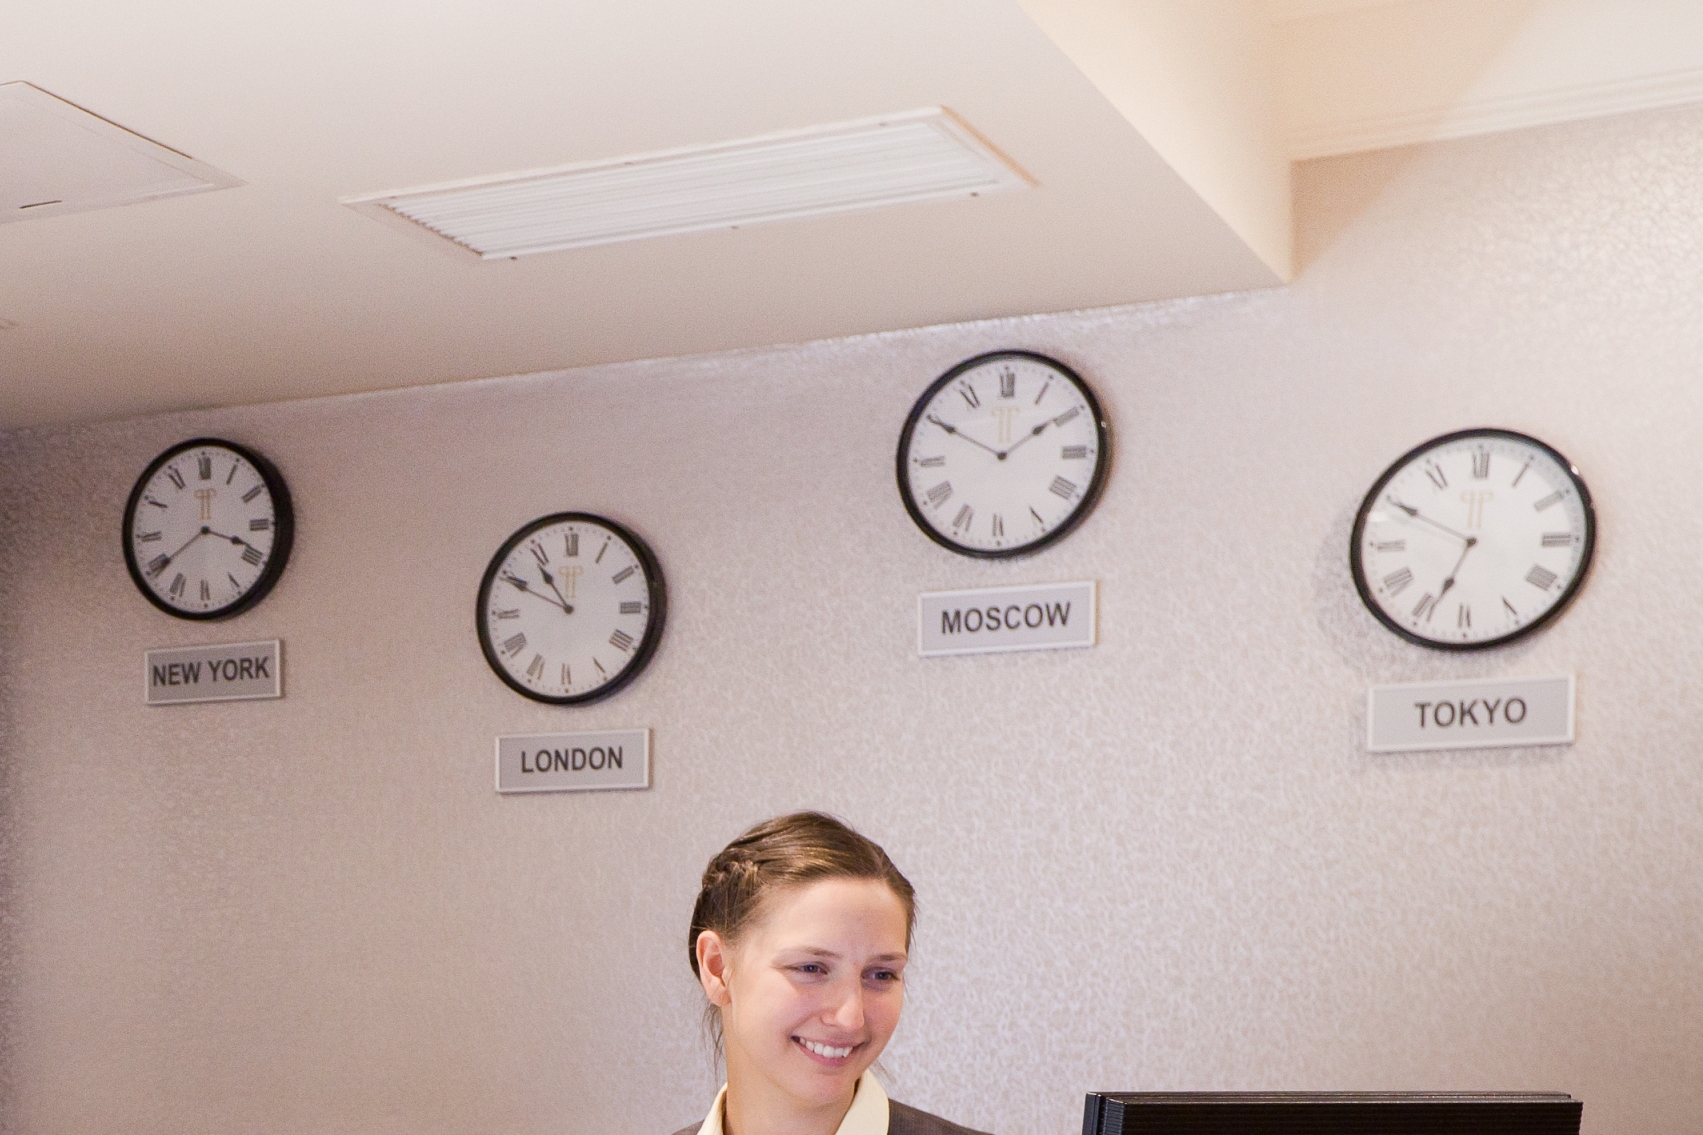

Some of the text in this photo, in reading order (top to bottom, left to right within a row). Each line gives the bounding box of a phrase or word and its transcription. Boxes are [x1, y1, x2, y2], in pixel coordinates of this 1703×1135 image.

[941, 602, 1072, 634] MOSCOW
[152, 656, 271, 687] NEW YORK
[1415, 698, 1527, 729] TOKYO
[520, 745, 623, 773] LONDON
